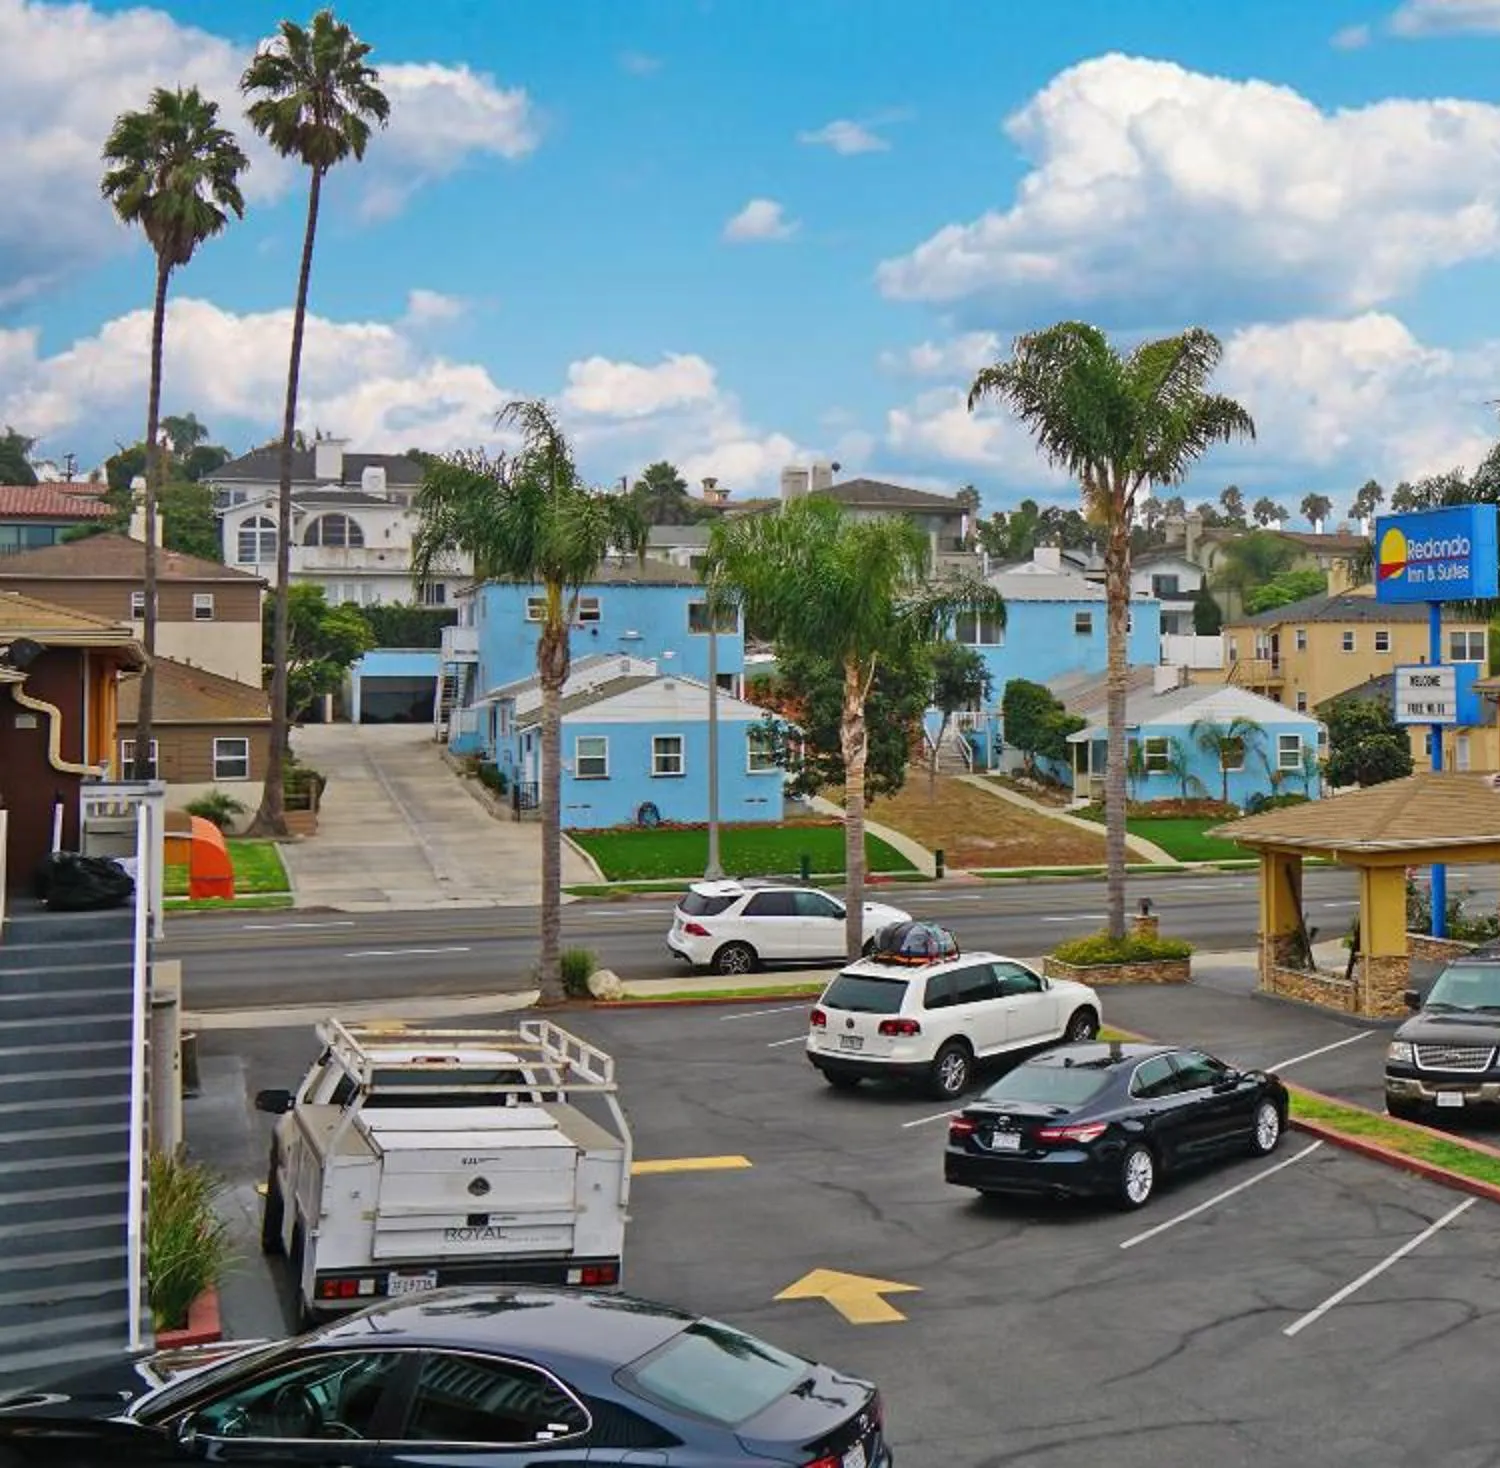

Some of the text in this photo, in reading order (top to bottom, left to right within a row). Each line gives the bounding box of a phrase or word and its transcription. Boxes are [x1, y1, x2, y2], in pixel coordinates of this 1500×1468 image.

[1407, 536, 1470, 560] Redondo
[1407, 563, 1469, 583] Inn & Suites
[1410, 675, 1441, 687] WELCOME
[1407, 703, 1423, 716] FREE
[445, 1227, 507, 1240] ROYAL
